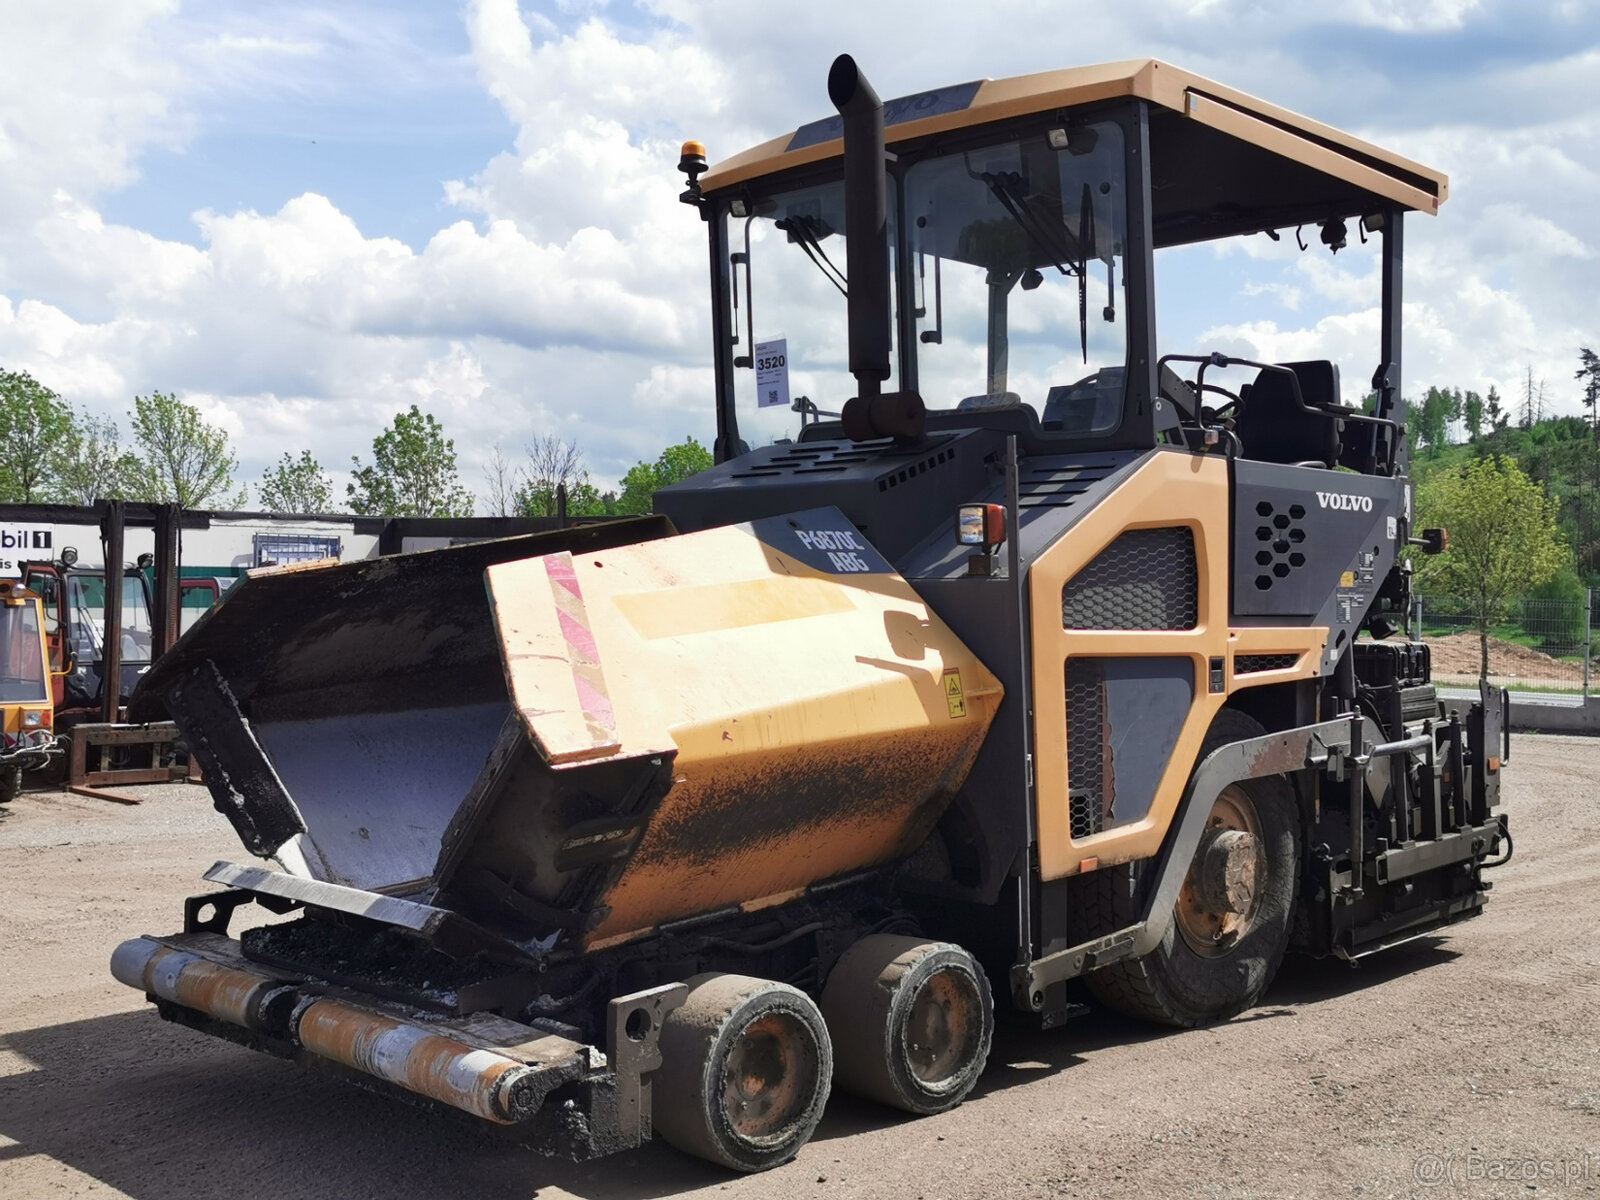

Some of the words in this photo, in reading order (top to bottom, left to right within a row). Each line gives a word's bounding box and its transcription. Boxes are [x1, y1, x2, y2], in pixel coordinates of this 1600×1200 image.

[757, 355, 786, 371] 3520
[1316, 491, 1373, 512] VOLVO
[1, 529, 28, 549] bil
[795, 530, 865, 550] P6870C
[827, 551, 870, 572] ABG
